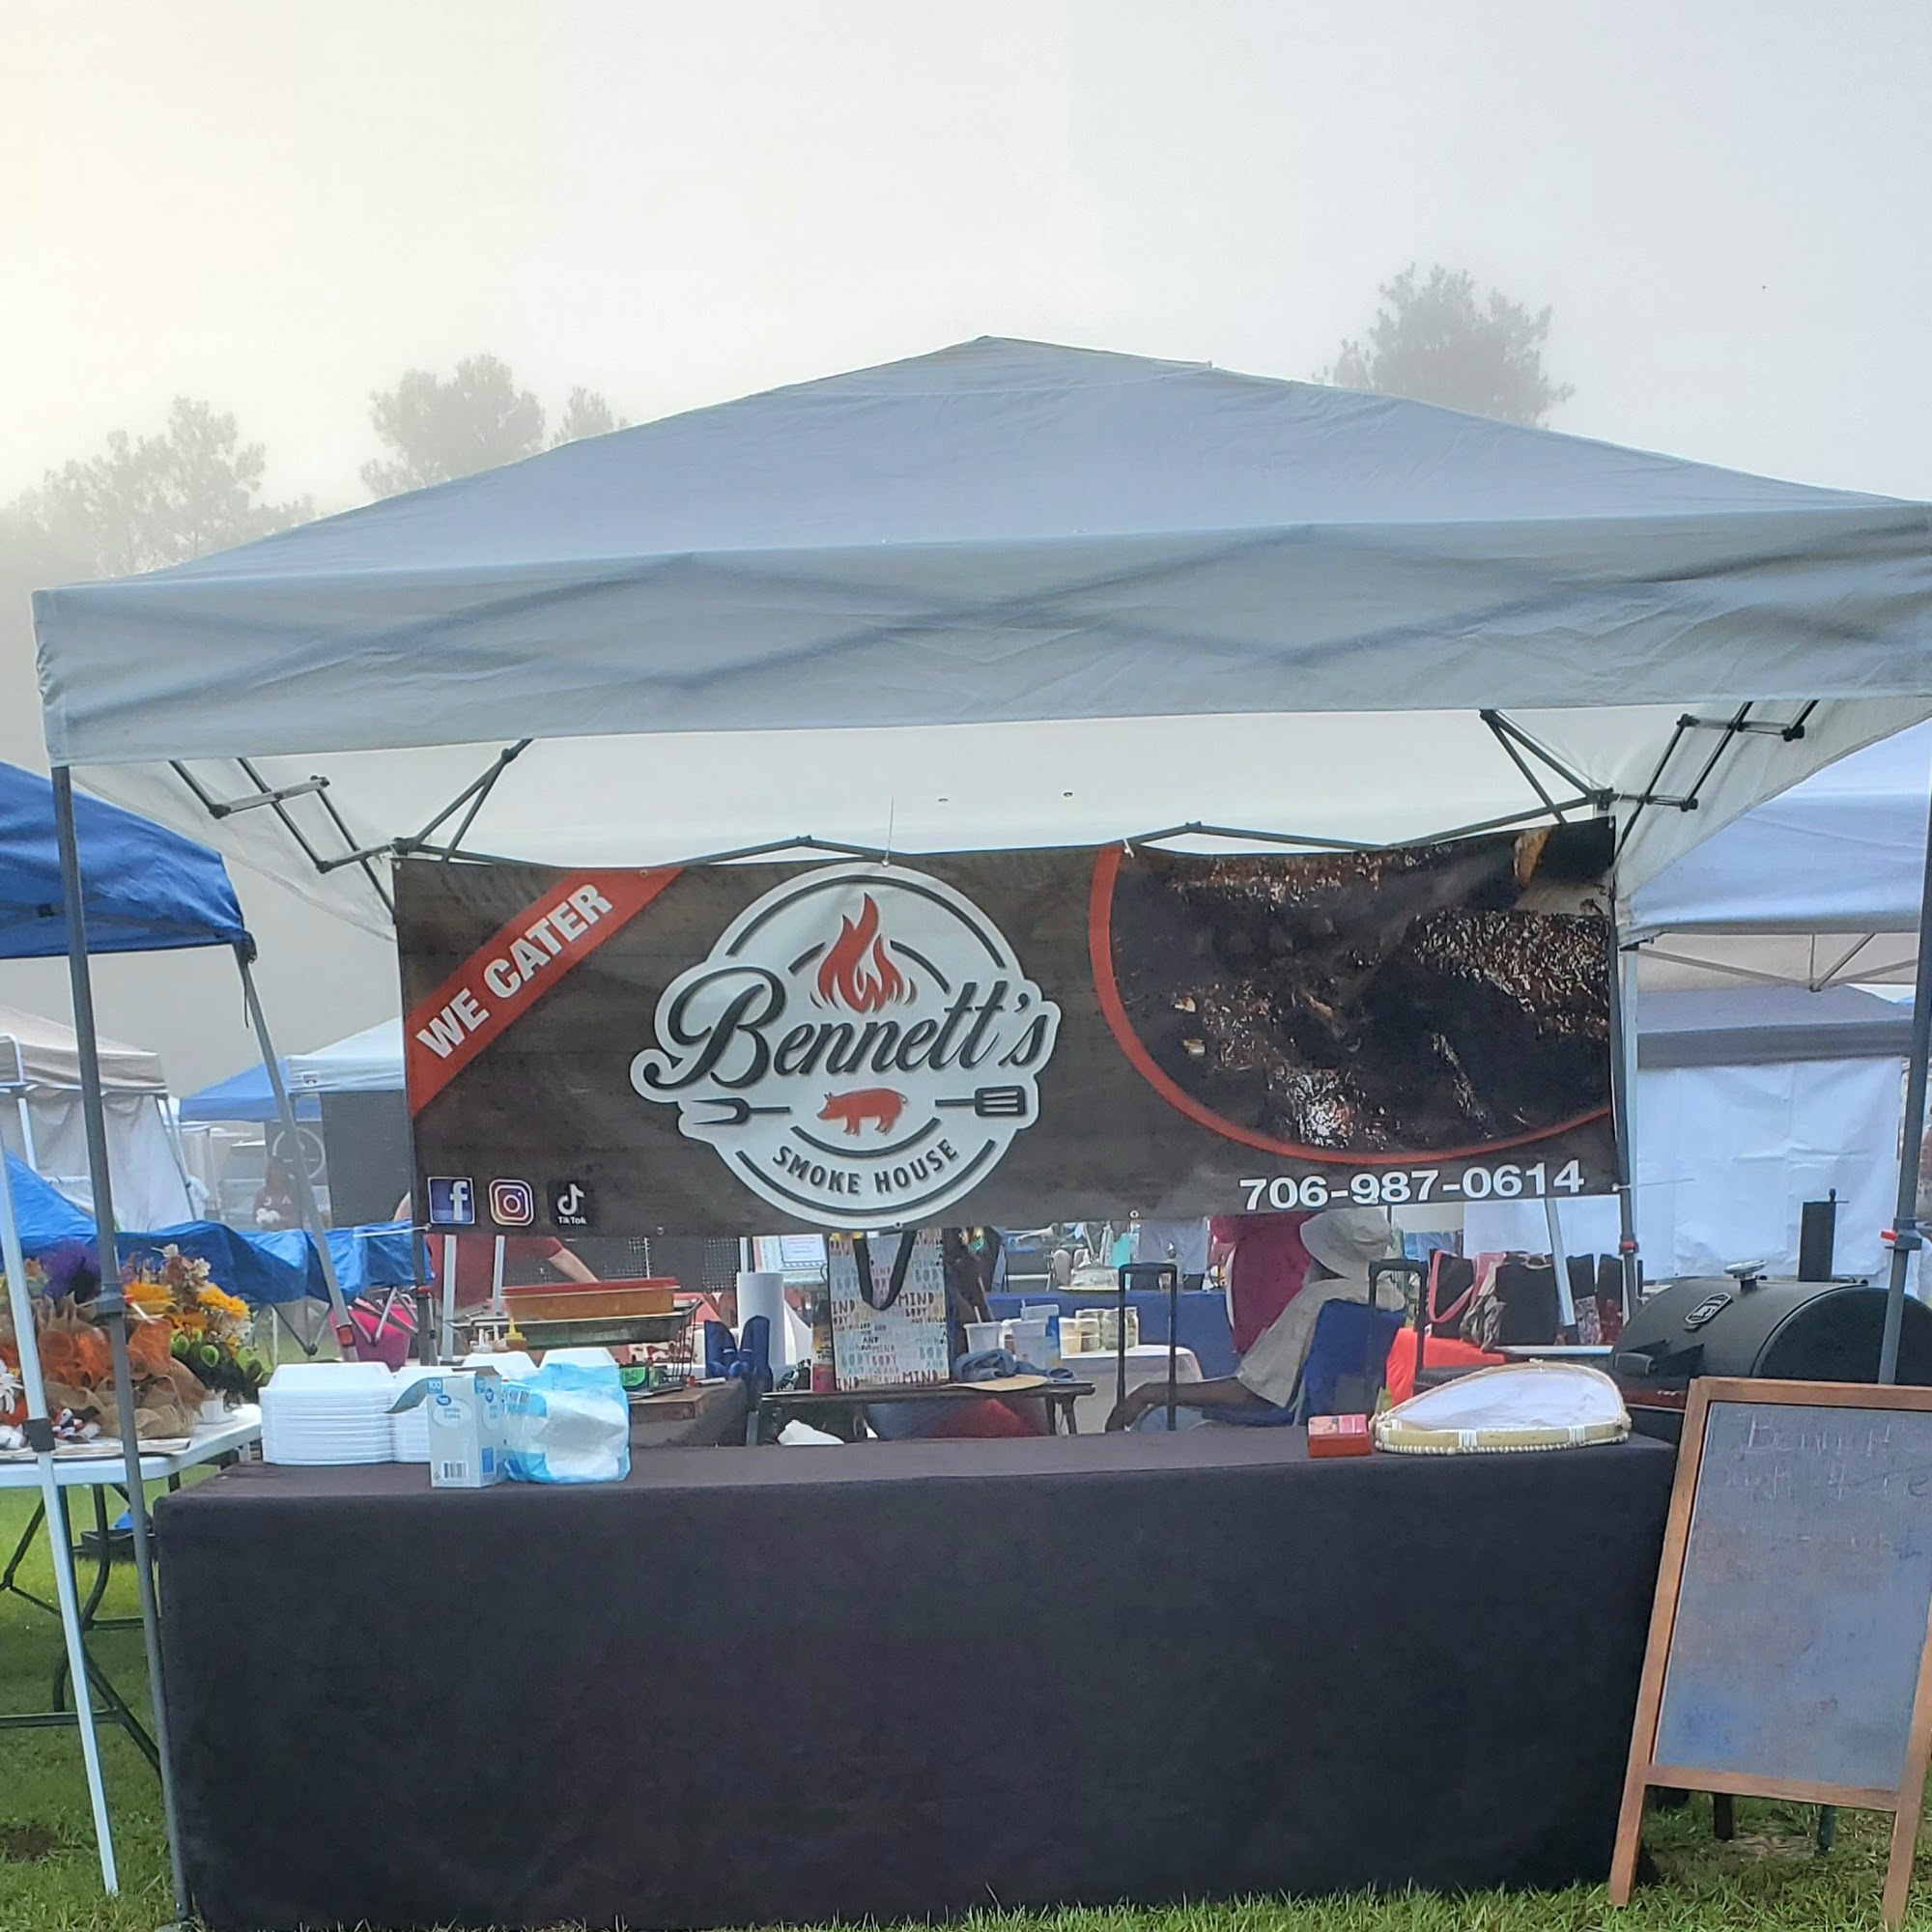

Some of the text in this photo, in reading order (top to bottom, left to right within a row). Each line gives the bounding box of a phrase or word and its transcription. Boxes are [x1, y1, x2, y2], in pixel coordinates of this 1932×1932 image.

[415, 884, 613, 1059] WE CATER
[643, 965, 1049, 1090] Bennett's
[772, 1138, 959, 1195] SMOKE HOUSE
[1238, 1159, 1585, 1211] 706-987-0614
[832, 1299, 856, 1315] IND
[898, 1292, 934, 1307] MIND
[905, 1307, 927, 1318] BODY
[428, 1379, 442, 1390] 100
